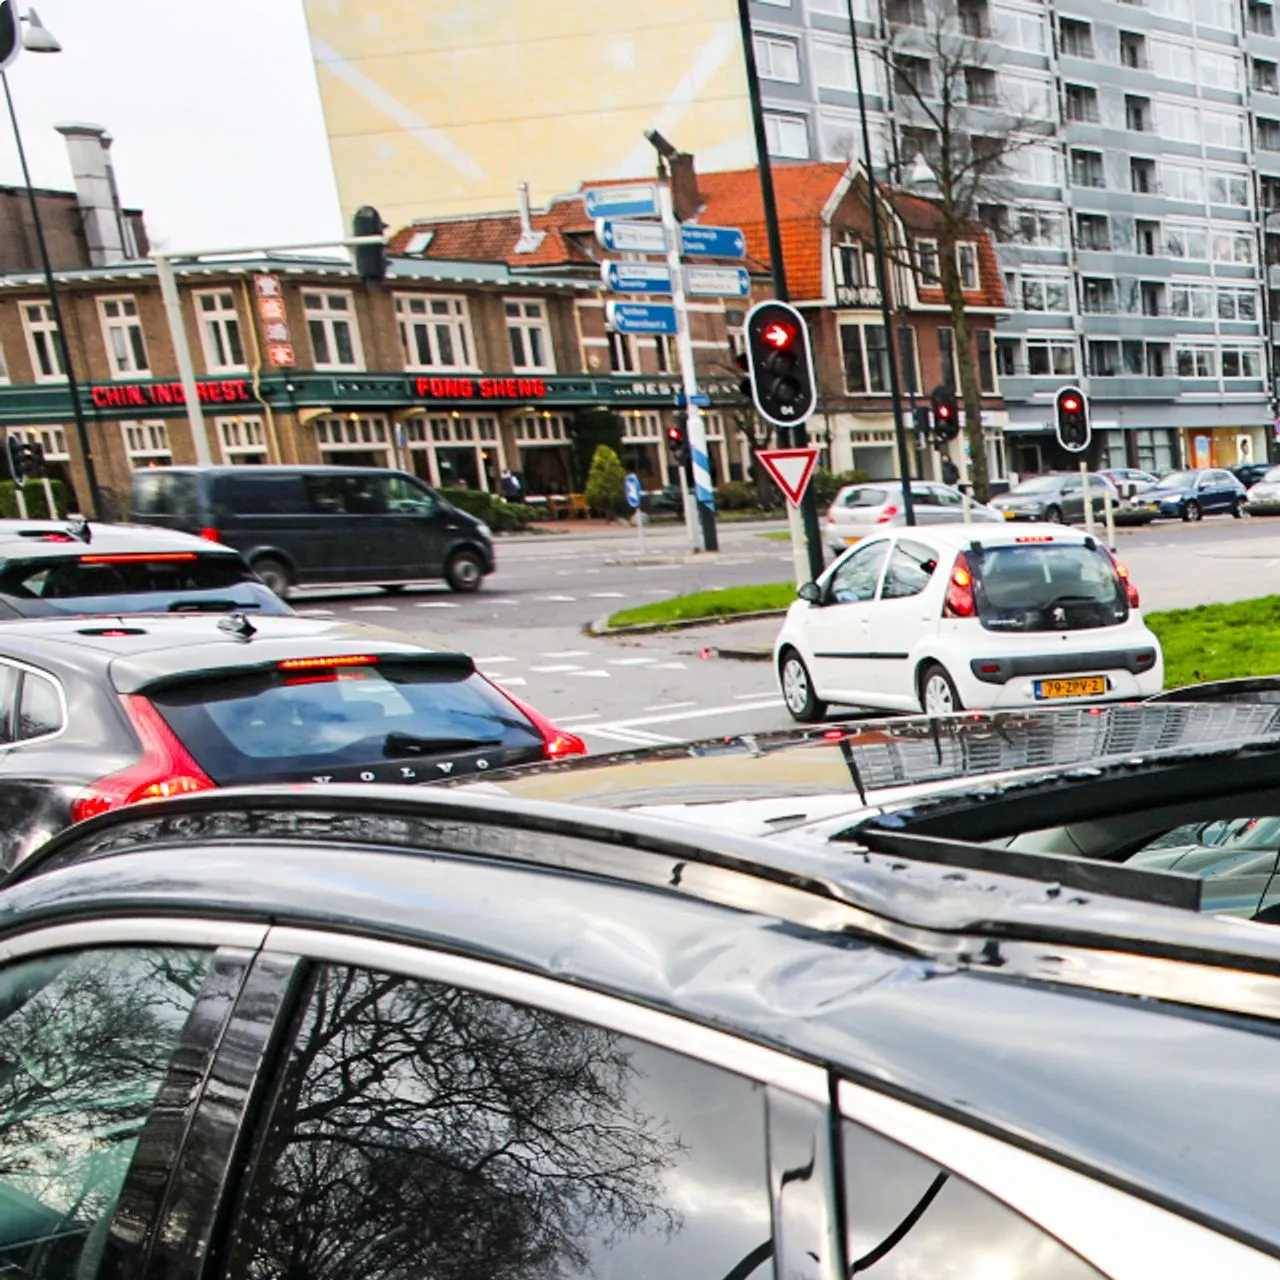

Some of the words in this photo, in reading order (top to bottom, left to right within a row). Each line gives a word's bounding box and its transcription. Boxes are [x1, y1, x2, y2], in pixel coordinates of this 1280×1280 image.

[415, 376, 474, 398] FONG
[478, 377, 546, 398] SHENG
[312, 758, 490, 784] VOLVO
